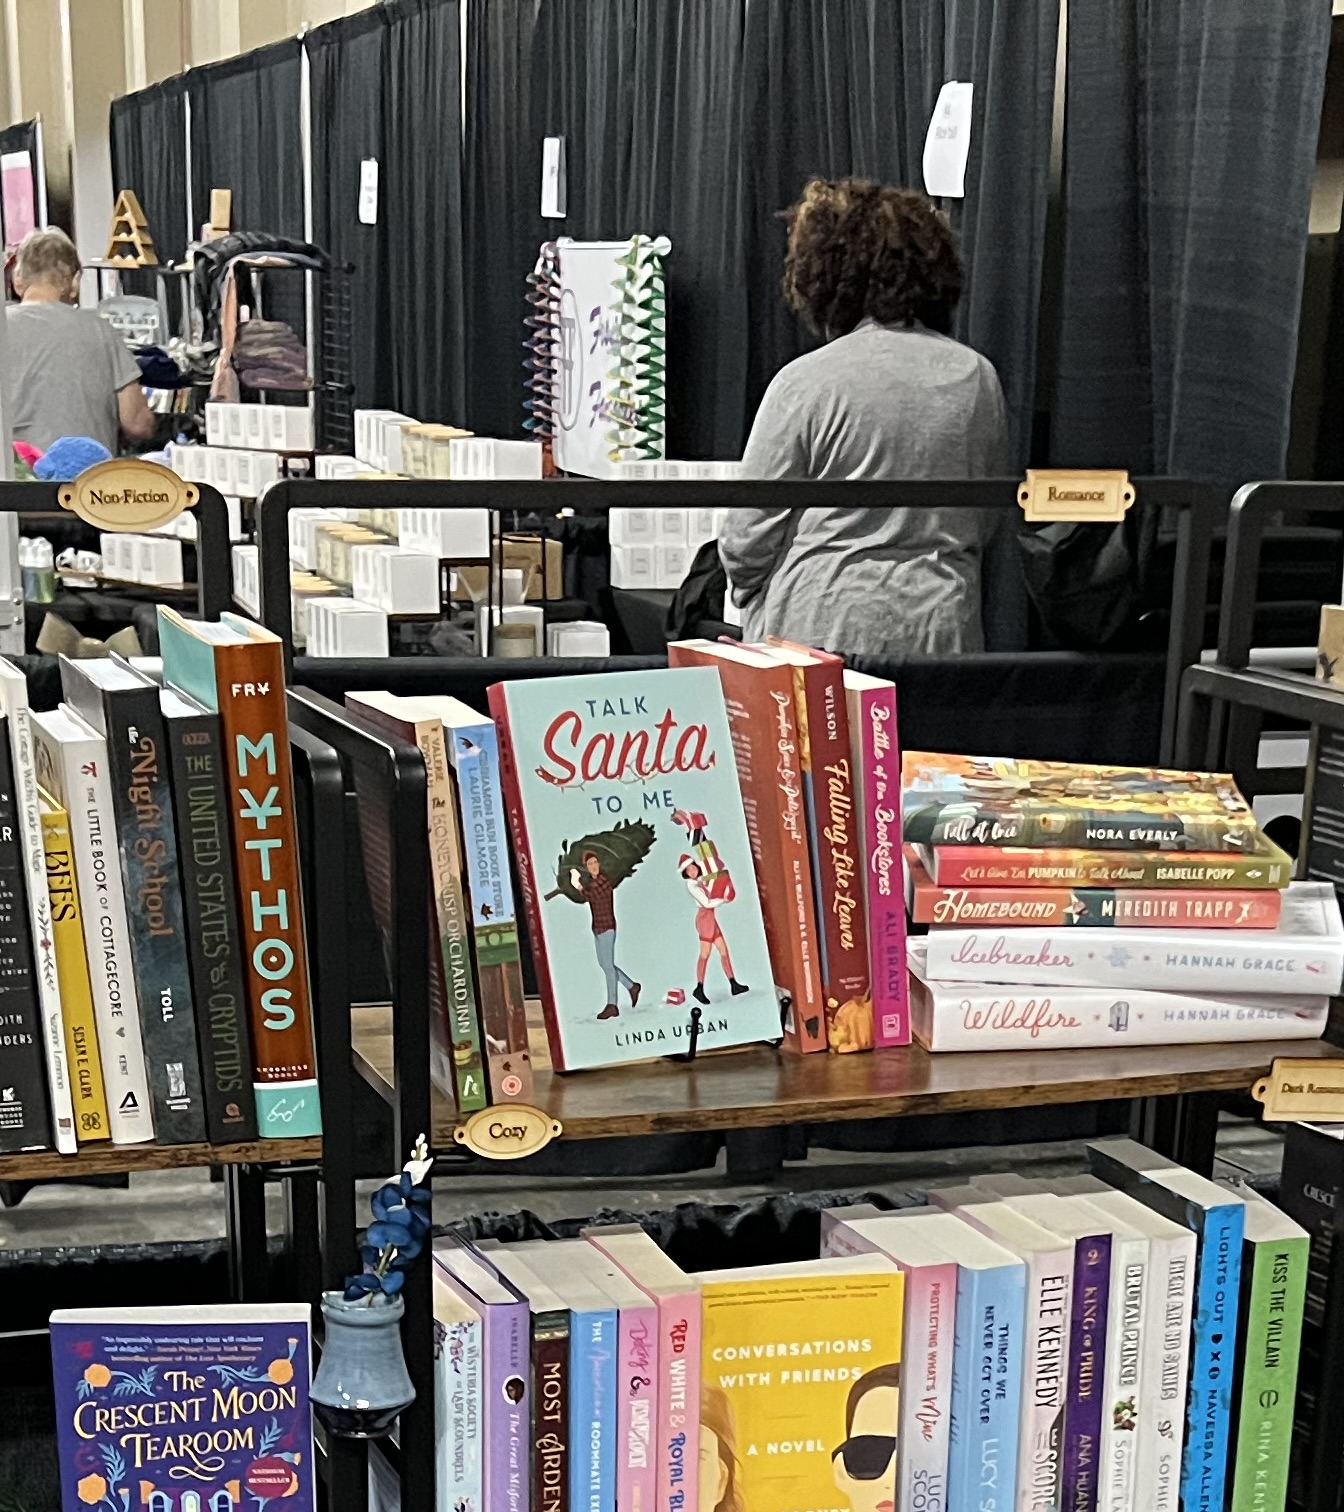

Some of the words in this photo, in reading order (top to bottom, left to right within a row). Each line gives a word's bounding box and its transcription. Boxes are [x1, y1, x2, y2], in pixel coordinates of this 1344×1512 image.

[90, 489, 169, 505] Non-Fiction
[1048, 487, 1104, 501] Romance
[586, 697, 648, 718] TALK
[824, 685, 836, 741] WILSON
[535, 708, 717, 786] Santa
[592, 797, 623, 814] TO
[643, 790, 674, 810] ME
[86, 809, 102, 847] LITTLE
[1086, 829, 1122, 839] NORA
[1129, 829, 1178, 841] EVERLY
[92, 851, 107, 892] BOOK
[235, 732, 295, 1030] MYTHOS
[1157, 868, 1204, 880] ISABELLE
[1206, 868, 1235, 880] POPP
[100, 916, 123, 1018] COTTAGECORE
[951, 939, 1074, 967] Icebreaker
[1166, 954, 1238, 969] HANNAH
[1243, 954, 1295, 972] GRACE
[160, 987, 174, 1023] TOLL
[615, 1029, 665, 1046] LINDA
[489, 1122, 528, 1140] Cozy
[1039, 1275, 1065, 1320] ELLE
[712, 1338, 872, 1361] CONVERSATIONS
[163, 1370, 206, 1392] The
[720, 1371, 771, 1388] WITH
[780, 1368, 863, 1384] FRIENDS
[1033, 1325, 1062, 1410] KENNEDY
[74, 1397, 206, 1438] CRESCENT
[210, 1386, 297, 1422] MOON
[119, 1426, 255, 1467] TEAROOM
[747, 1443, 759, 1457] A
[767, 1440, 825, 1454] NOVEL
